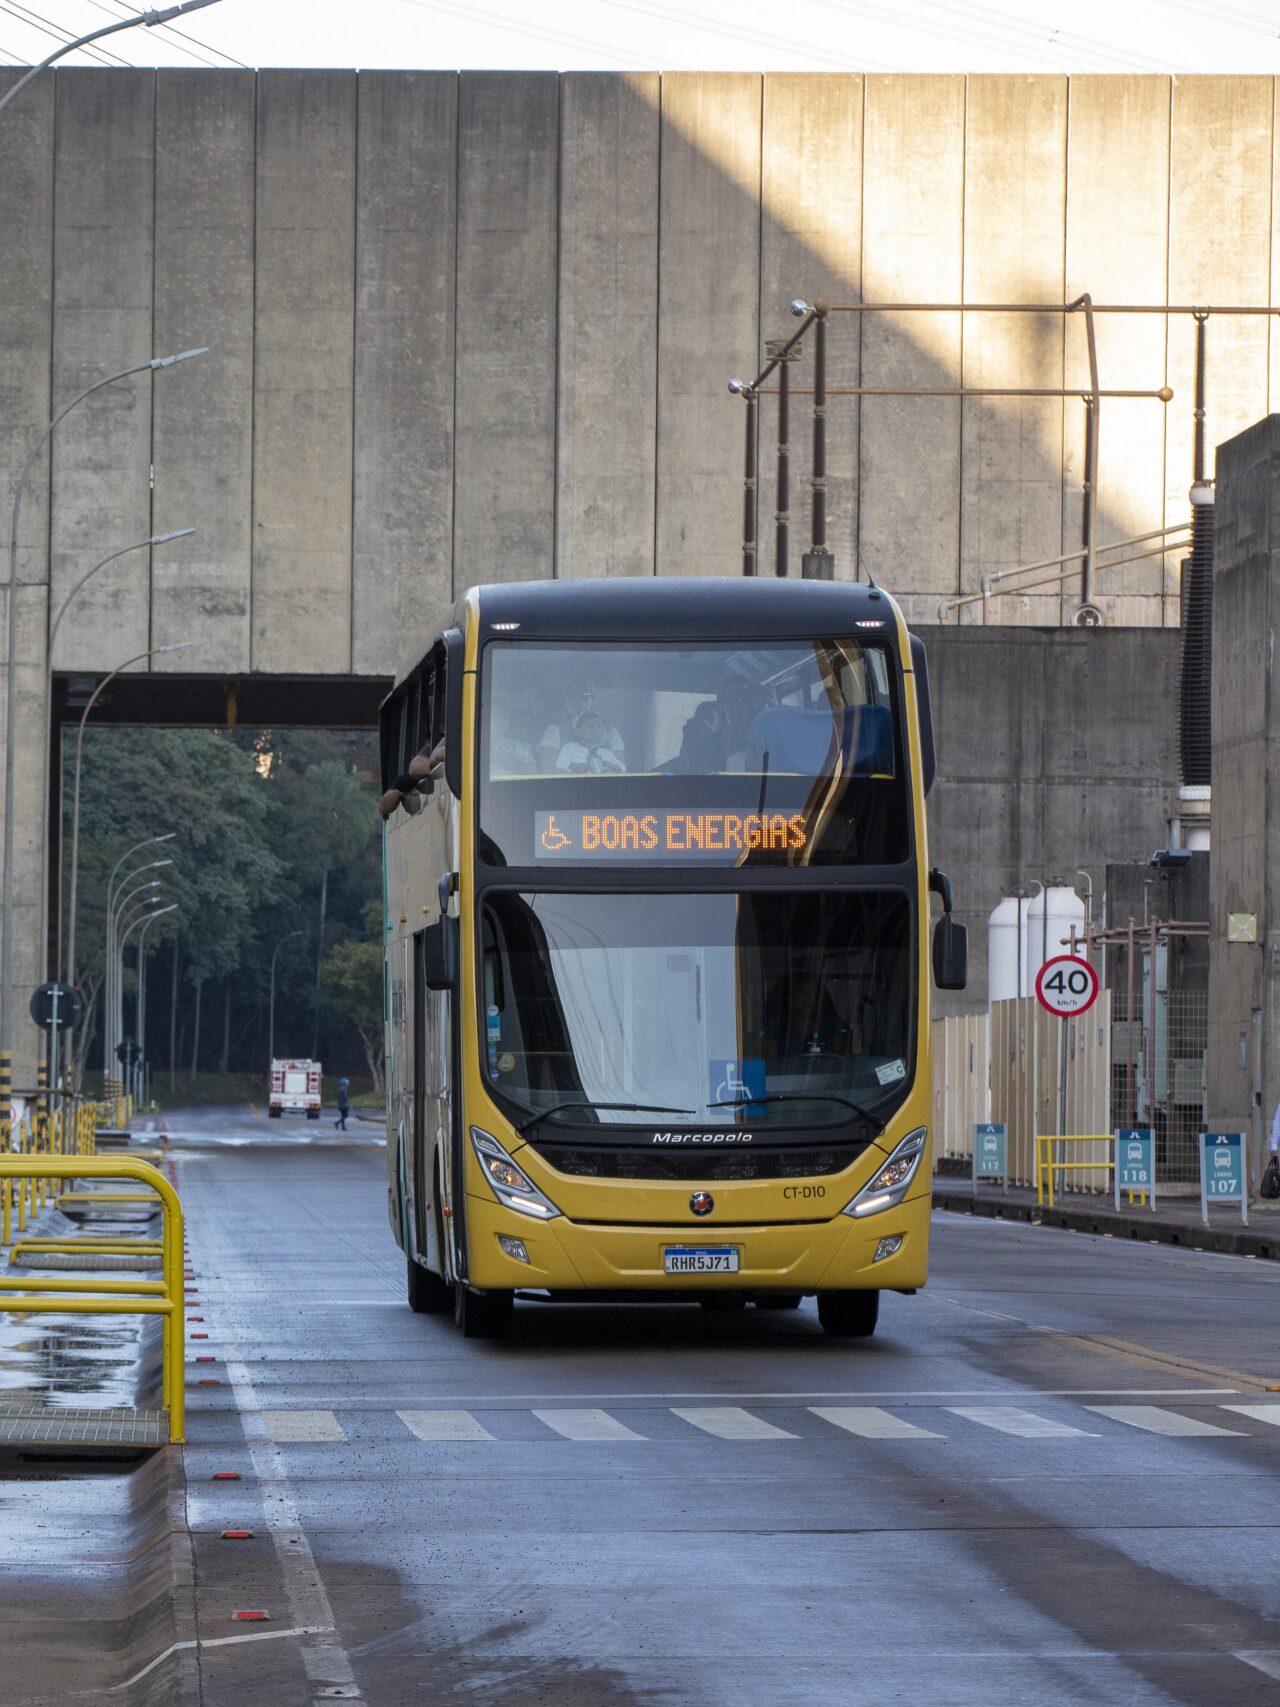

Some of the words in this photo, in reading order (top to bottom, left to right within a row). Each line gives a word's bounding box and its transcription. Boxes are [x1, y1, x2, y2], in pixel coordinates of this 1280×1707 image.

[582, 815, 658, 849] BOAS
[666, 815, 807, 849] ENERGIAS
[1044, 970, 1088, 994] 40
[653, 1132, 753, 1143] Marcopolo
[982, 1161, 999, 1170] 117
[1123, 1170, 1147, 1181] 118
[783, 1186, 826, 1199] CT-D10
[1210, 1180, 1237, 1193] 107
[671, 1256, 731, 1270] RHR5J71
